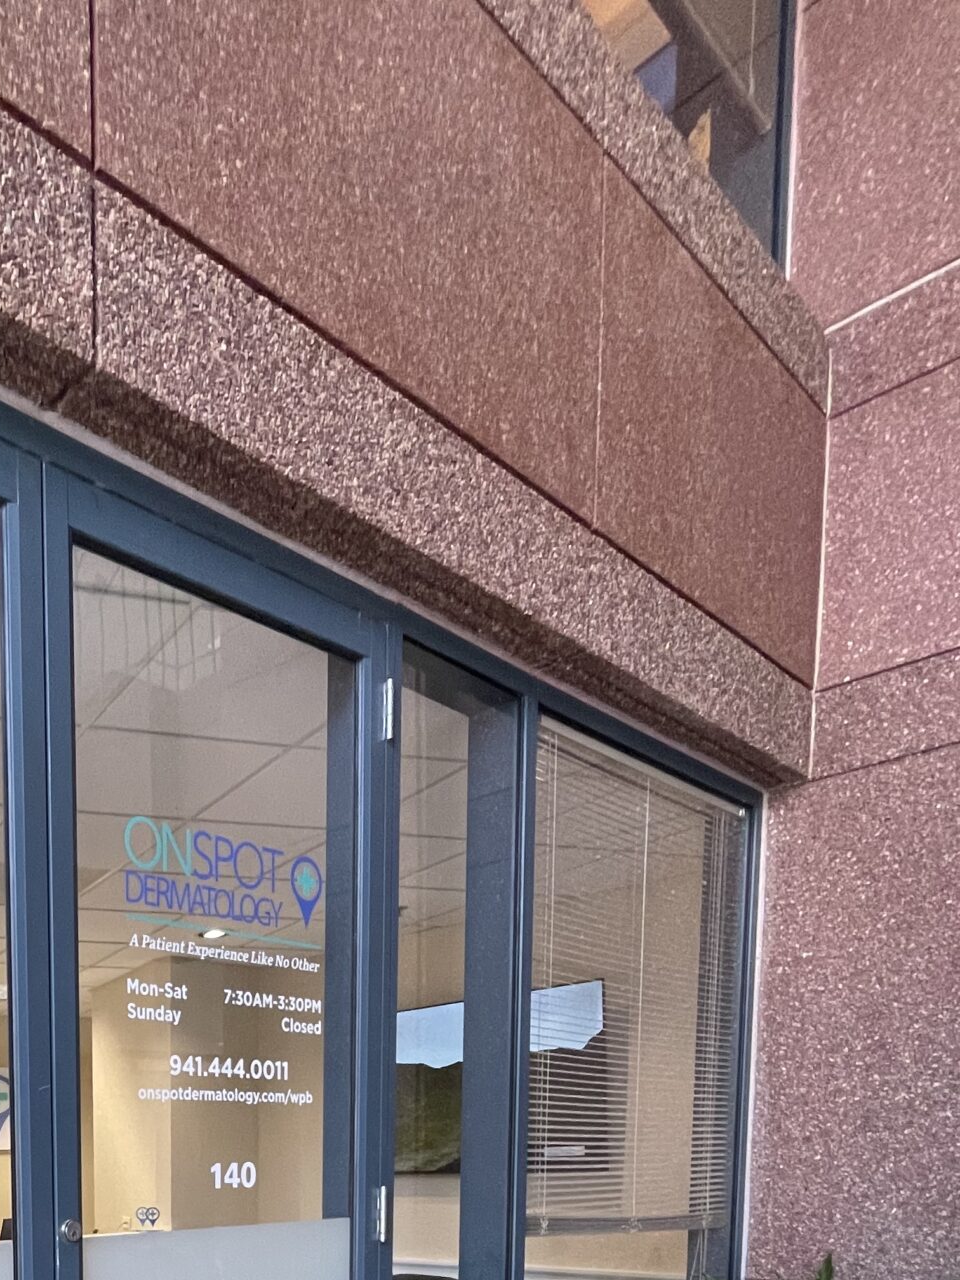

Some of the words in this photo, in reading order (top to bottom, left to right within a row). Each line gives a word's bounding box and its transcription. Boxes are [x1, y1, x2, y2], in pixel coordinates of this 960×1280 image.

[124, 815, 285, 893] ONSPOT
[125, 869, 284, 928] DERMATOLOGY
[129, 933, 140, 947] A
[142, 934, 185, 953] Patient
[187, 941, 249, 963] Experience
[251, 950, 274, 966] Like
[275, 955, 290, 969] No
[291, 957, 320, 973] Other
[126, 978, 188, 1000] Mon-Sat
[223, 989, 322, 1014] 7:30AM-3:30PM
[127, 1003, 182, 1026] Sunday
[281, 1017, 322, 1035] Closed
[169, 1055, 289, 1081] 941.444.0011
[138, 1086, 313, 1106] onspotdermatology.com/wpb
[210, 1161, 257, 1190] 140
